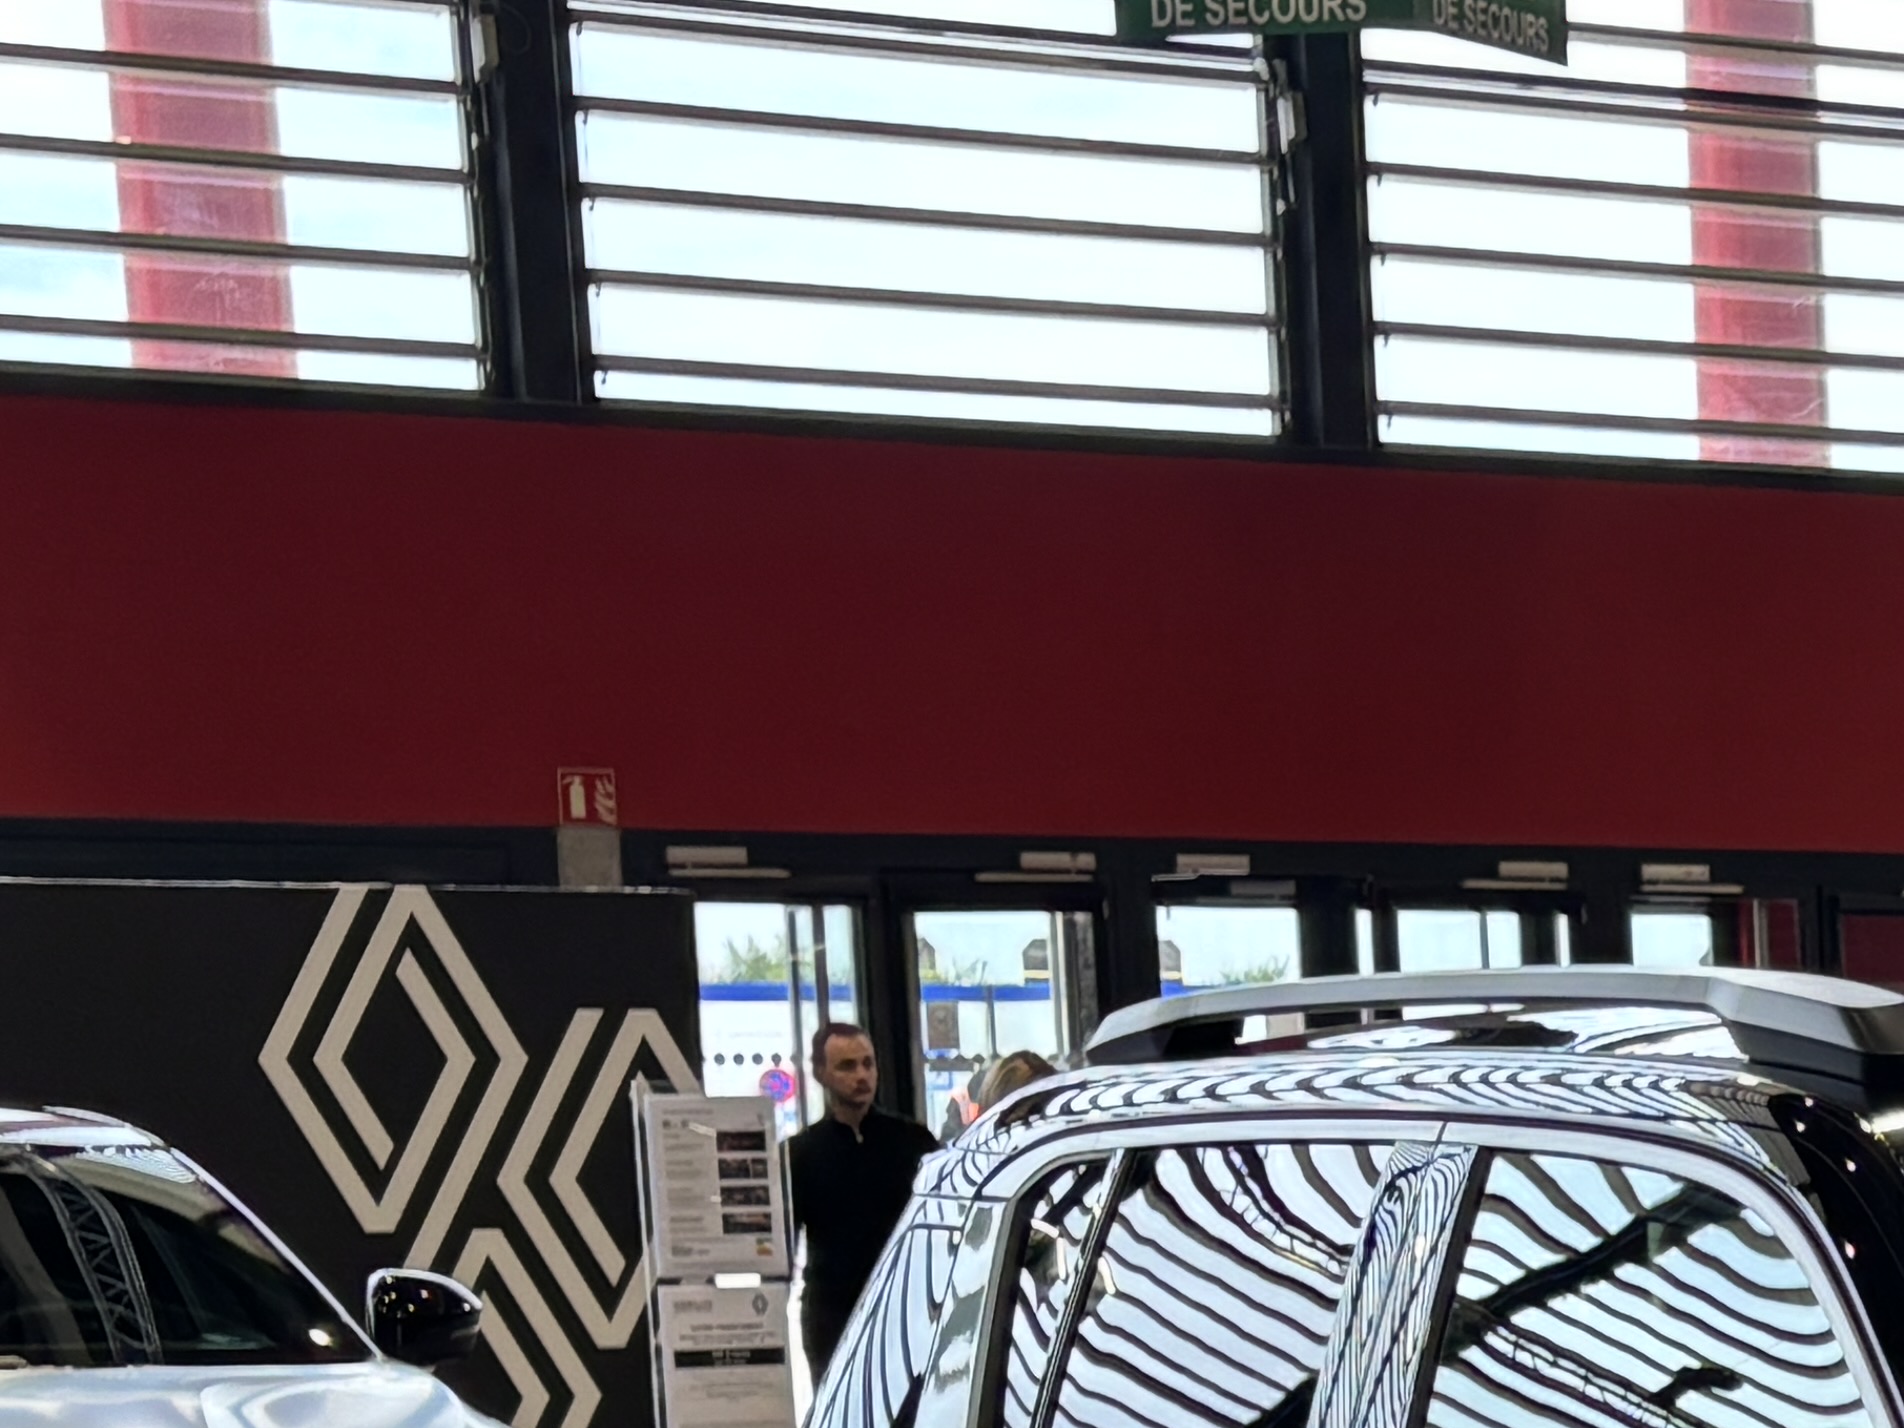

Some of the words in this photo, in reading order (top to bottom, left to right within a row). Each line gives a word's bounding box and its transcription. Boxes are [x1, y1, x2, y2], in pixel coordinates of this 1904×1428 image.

[1151, 0, 1195, 28] DE
[1205, 0, 1367, 26] SECOURS
[1432, 0, 1459, 30] DE
[1463, 0, 1550, 52] SECOURS
